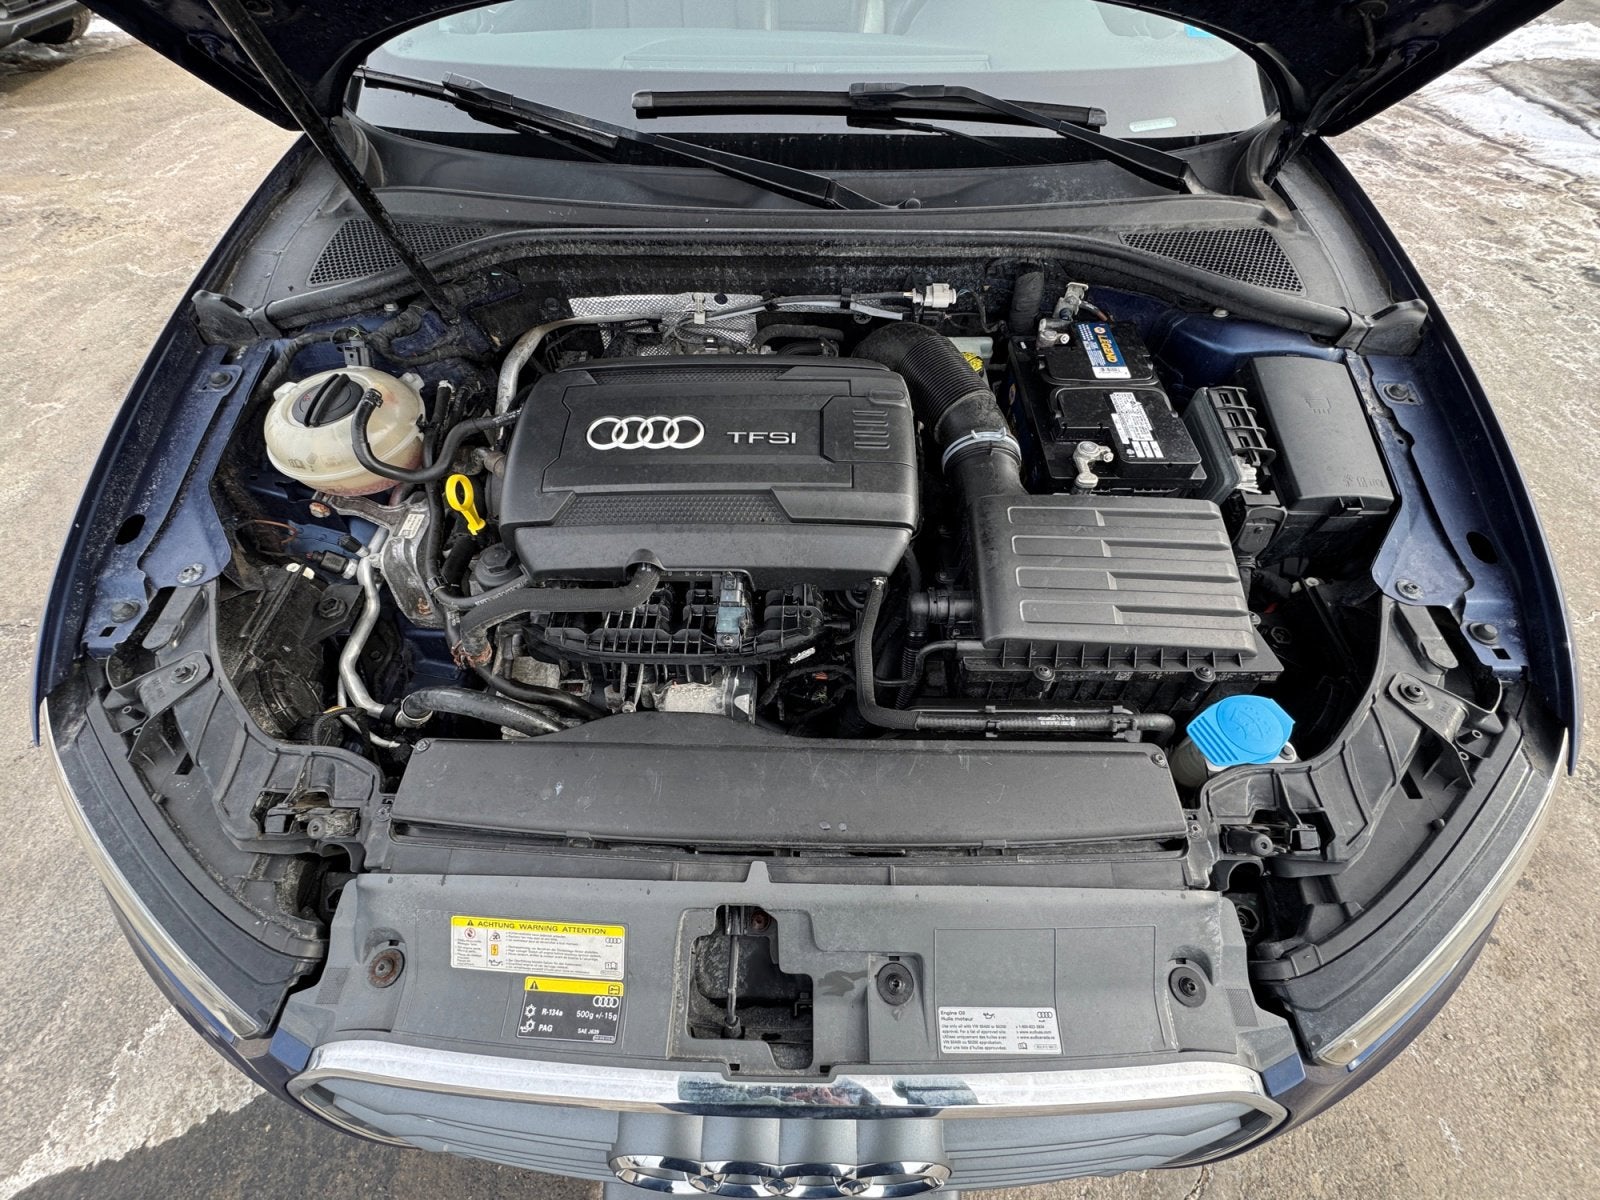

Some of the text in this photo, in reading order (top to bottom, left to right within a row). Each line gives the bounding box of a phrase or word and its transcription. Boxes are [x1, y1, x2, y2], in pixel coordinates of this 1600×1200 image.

[1097, 335, 1118, 363] LEGEND
[727, 431, 796, 444] TFSI
[477, 920, 606, 934] ACHTUNG WARNING ATTENTION
[542, 1008, 564, 1016] R-134a
[576, 1010, 594, 1020] 500g
[538, 1024, 553, 1032] PAG
